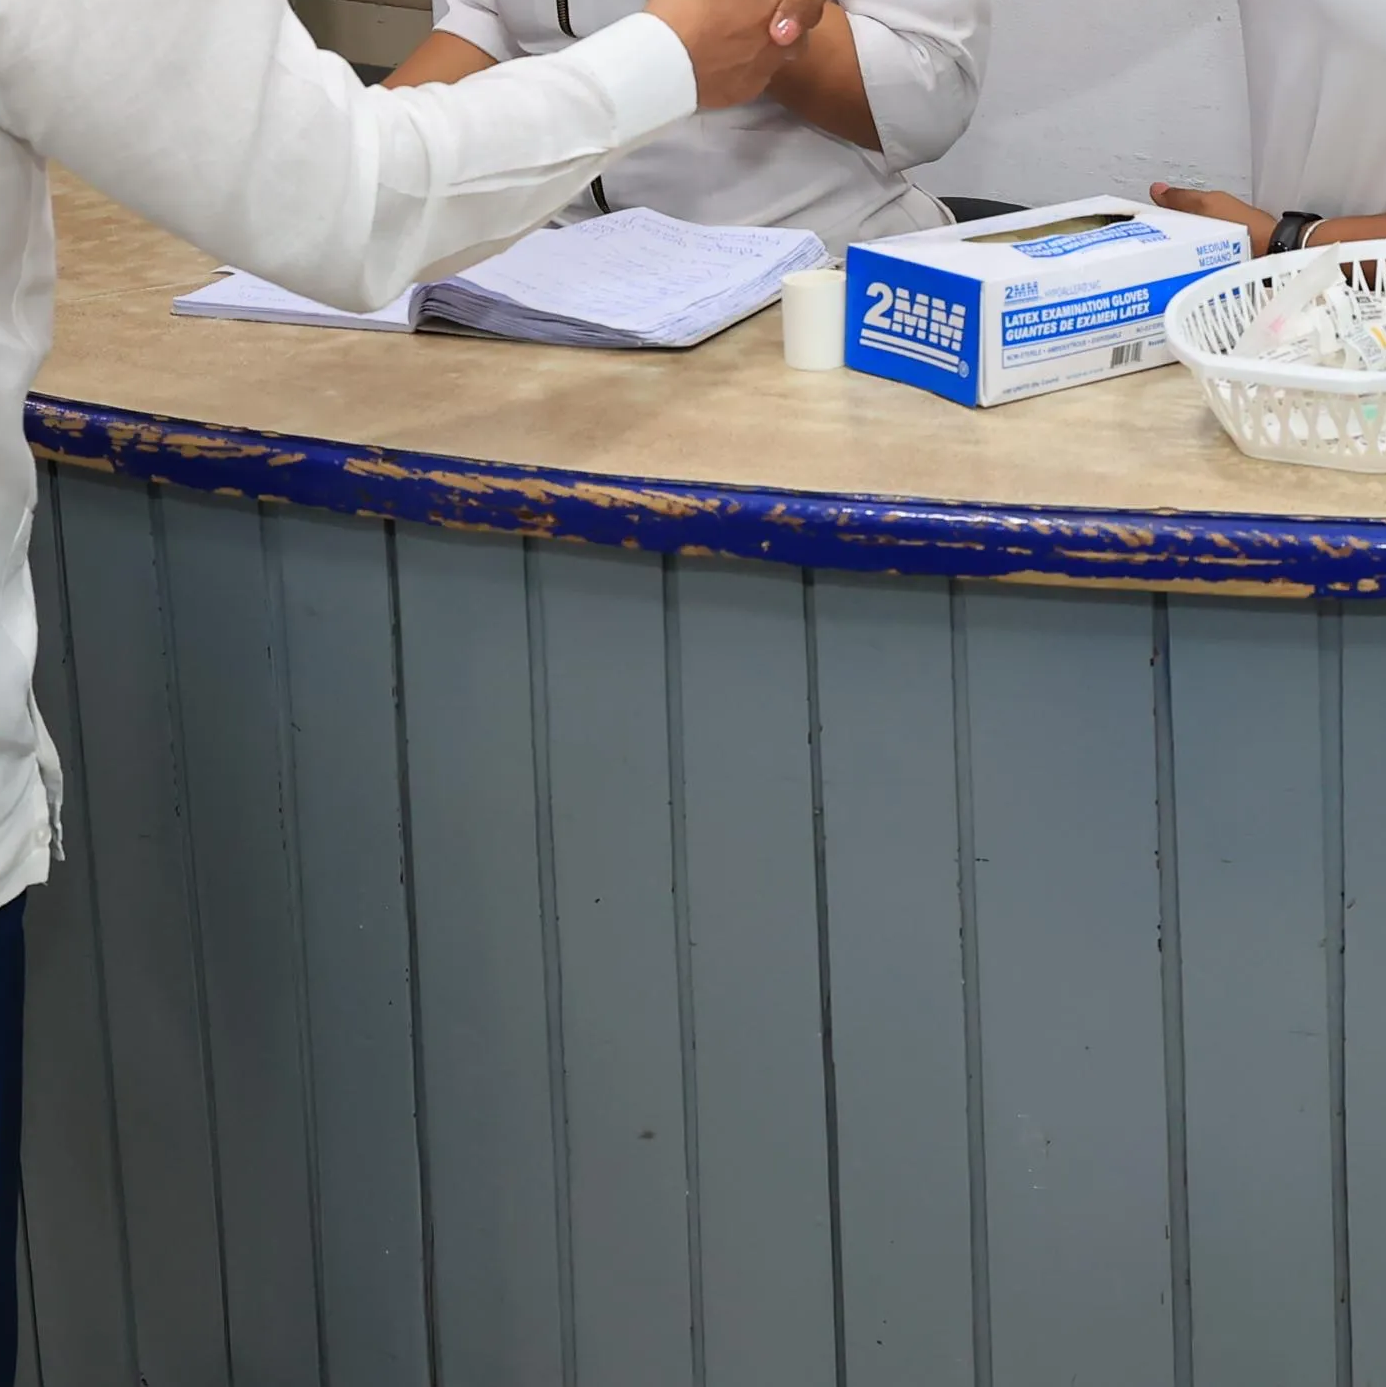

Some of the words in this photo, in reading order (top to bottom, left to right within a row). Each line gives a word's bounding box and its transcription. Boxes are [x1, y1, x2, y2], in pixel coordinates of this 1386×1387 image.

[1196, 240, 1230, 255] MEDIUM
[1199, 252, 1231, 266] MEDIANO
[1005, 311, 1040, 328] LATEX
[1041, 298, 1110, 320] EXAMINATION
[1112, 288, 1149, 305] GLOVES
[1005, 320, 1057, 342] GUANTES
[1059, 319, 1075, 332] DE
[1077, 309, 1118, 328] EXAMEN
[1120, 301, 1150, 319] LATEX
